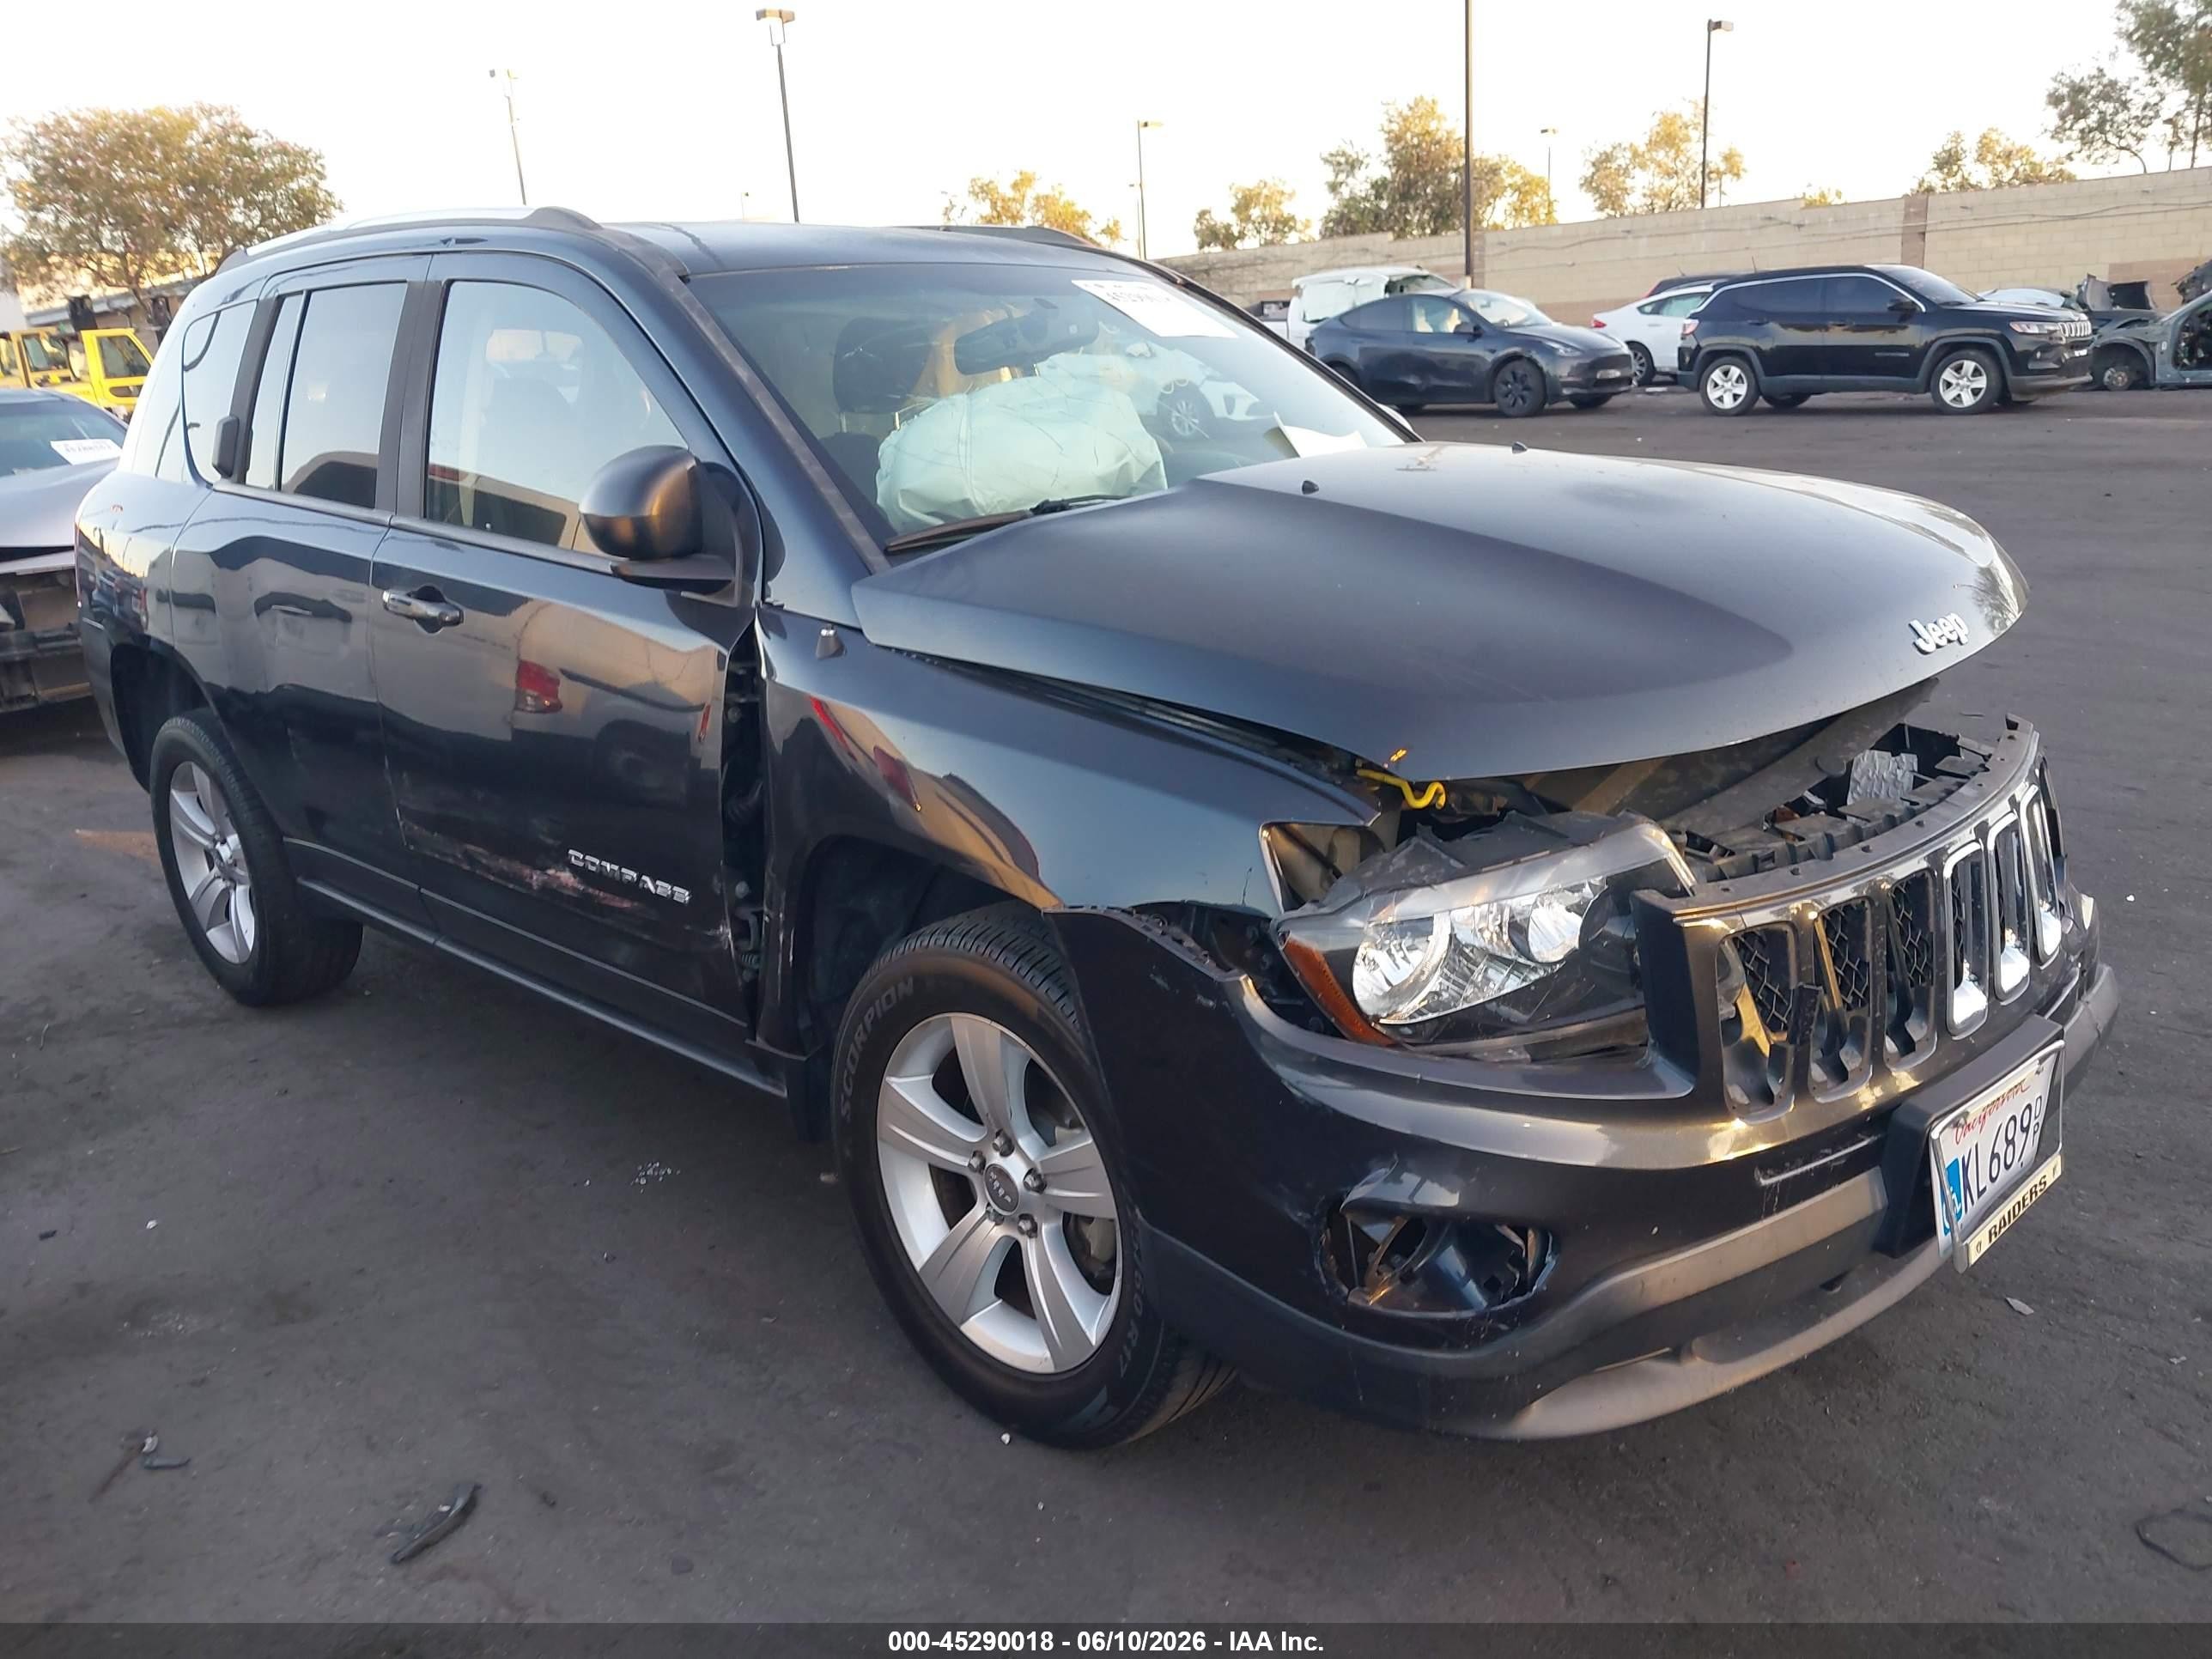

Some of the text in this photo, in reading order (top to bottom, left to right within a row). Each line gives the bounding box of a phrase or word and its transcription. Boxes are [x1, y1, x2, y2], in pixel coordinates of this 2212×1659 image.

[1908, 612, 1968, 655] Jeep
[568, 848, 691, 904] COMPASS
[841, 975, 914, 1122] SCORPION
[1988, 1175, 2047, 1243] RAIDERS
